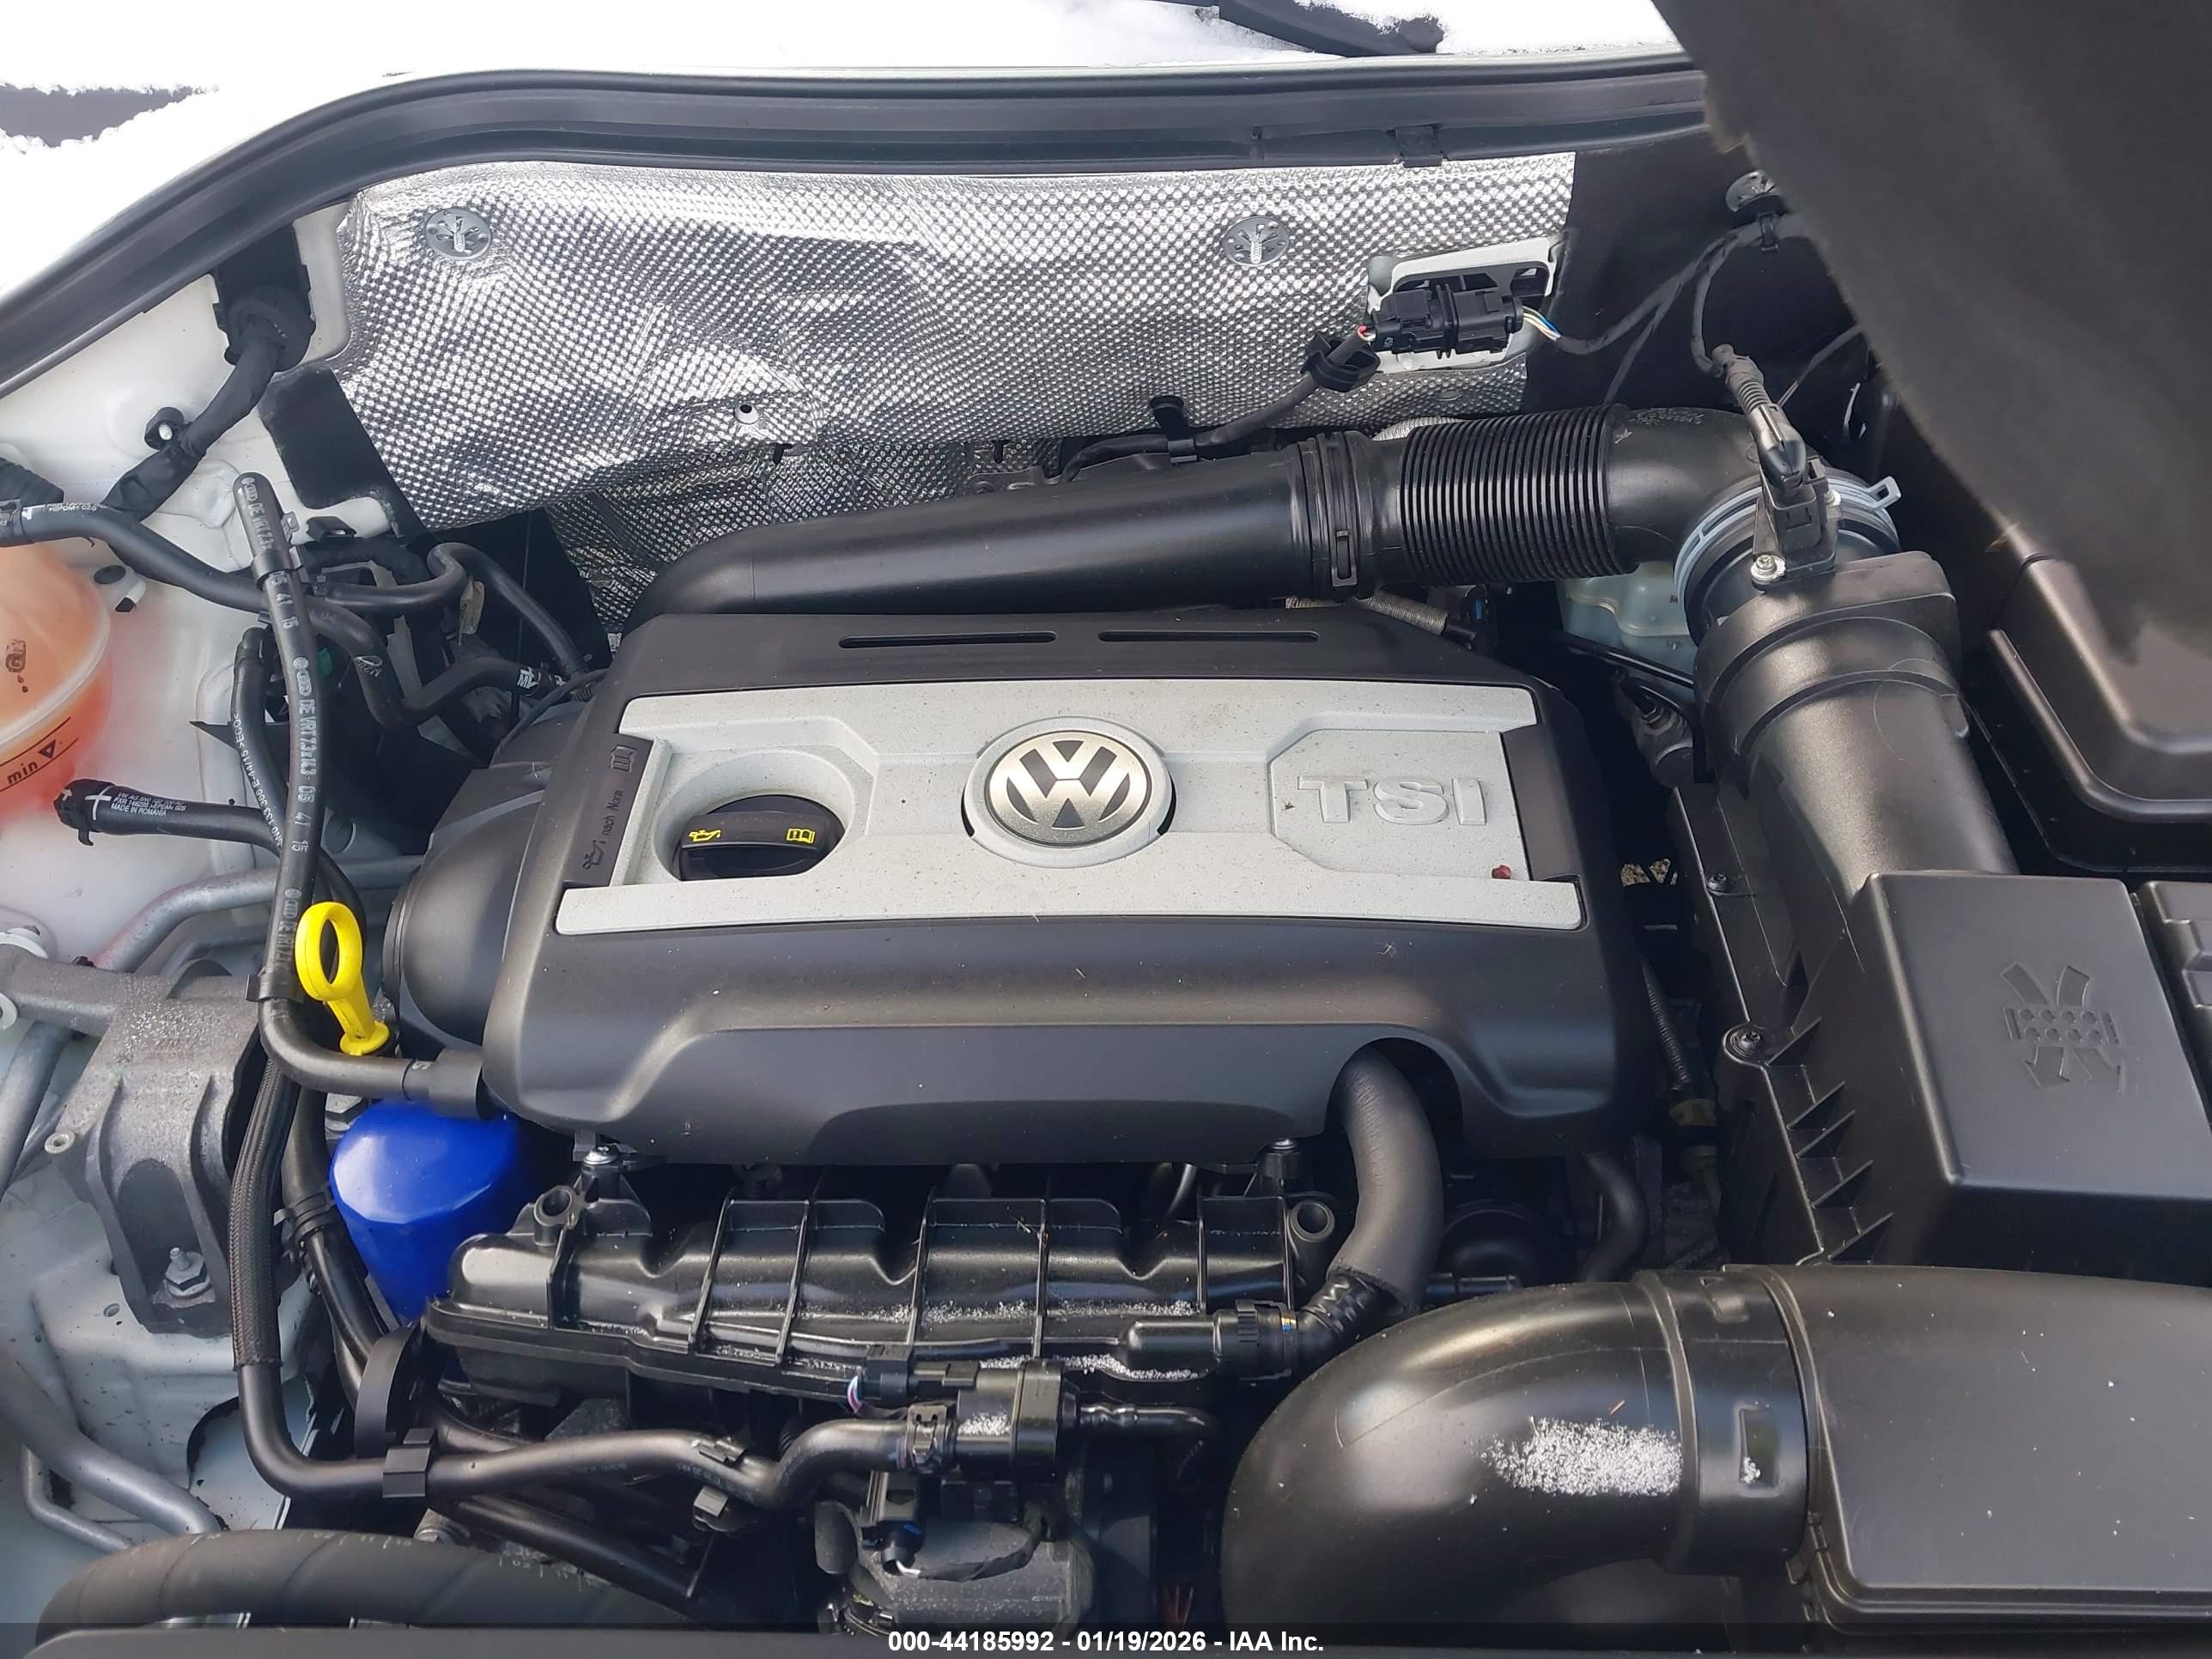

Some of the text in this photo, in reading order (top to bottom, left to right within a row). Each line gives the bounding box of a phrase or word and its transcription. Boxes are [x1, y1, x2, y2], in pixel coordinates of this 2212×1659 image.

[7, 761, 38, 784] min
[110, 803, 130, 812] MADE
[137, 807, 167, 817] ROMANIA
[1297, 775, 1487, 826] TSI
